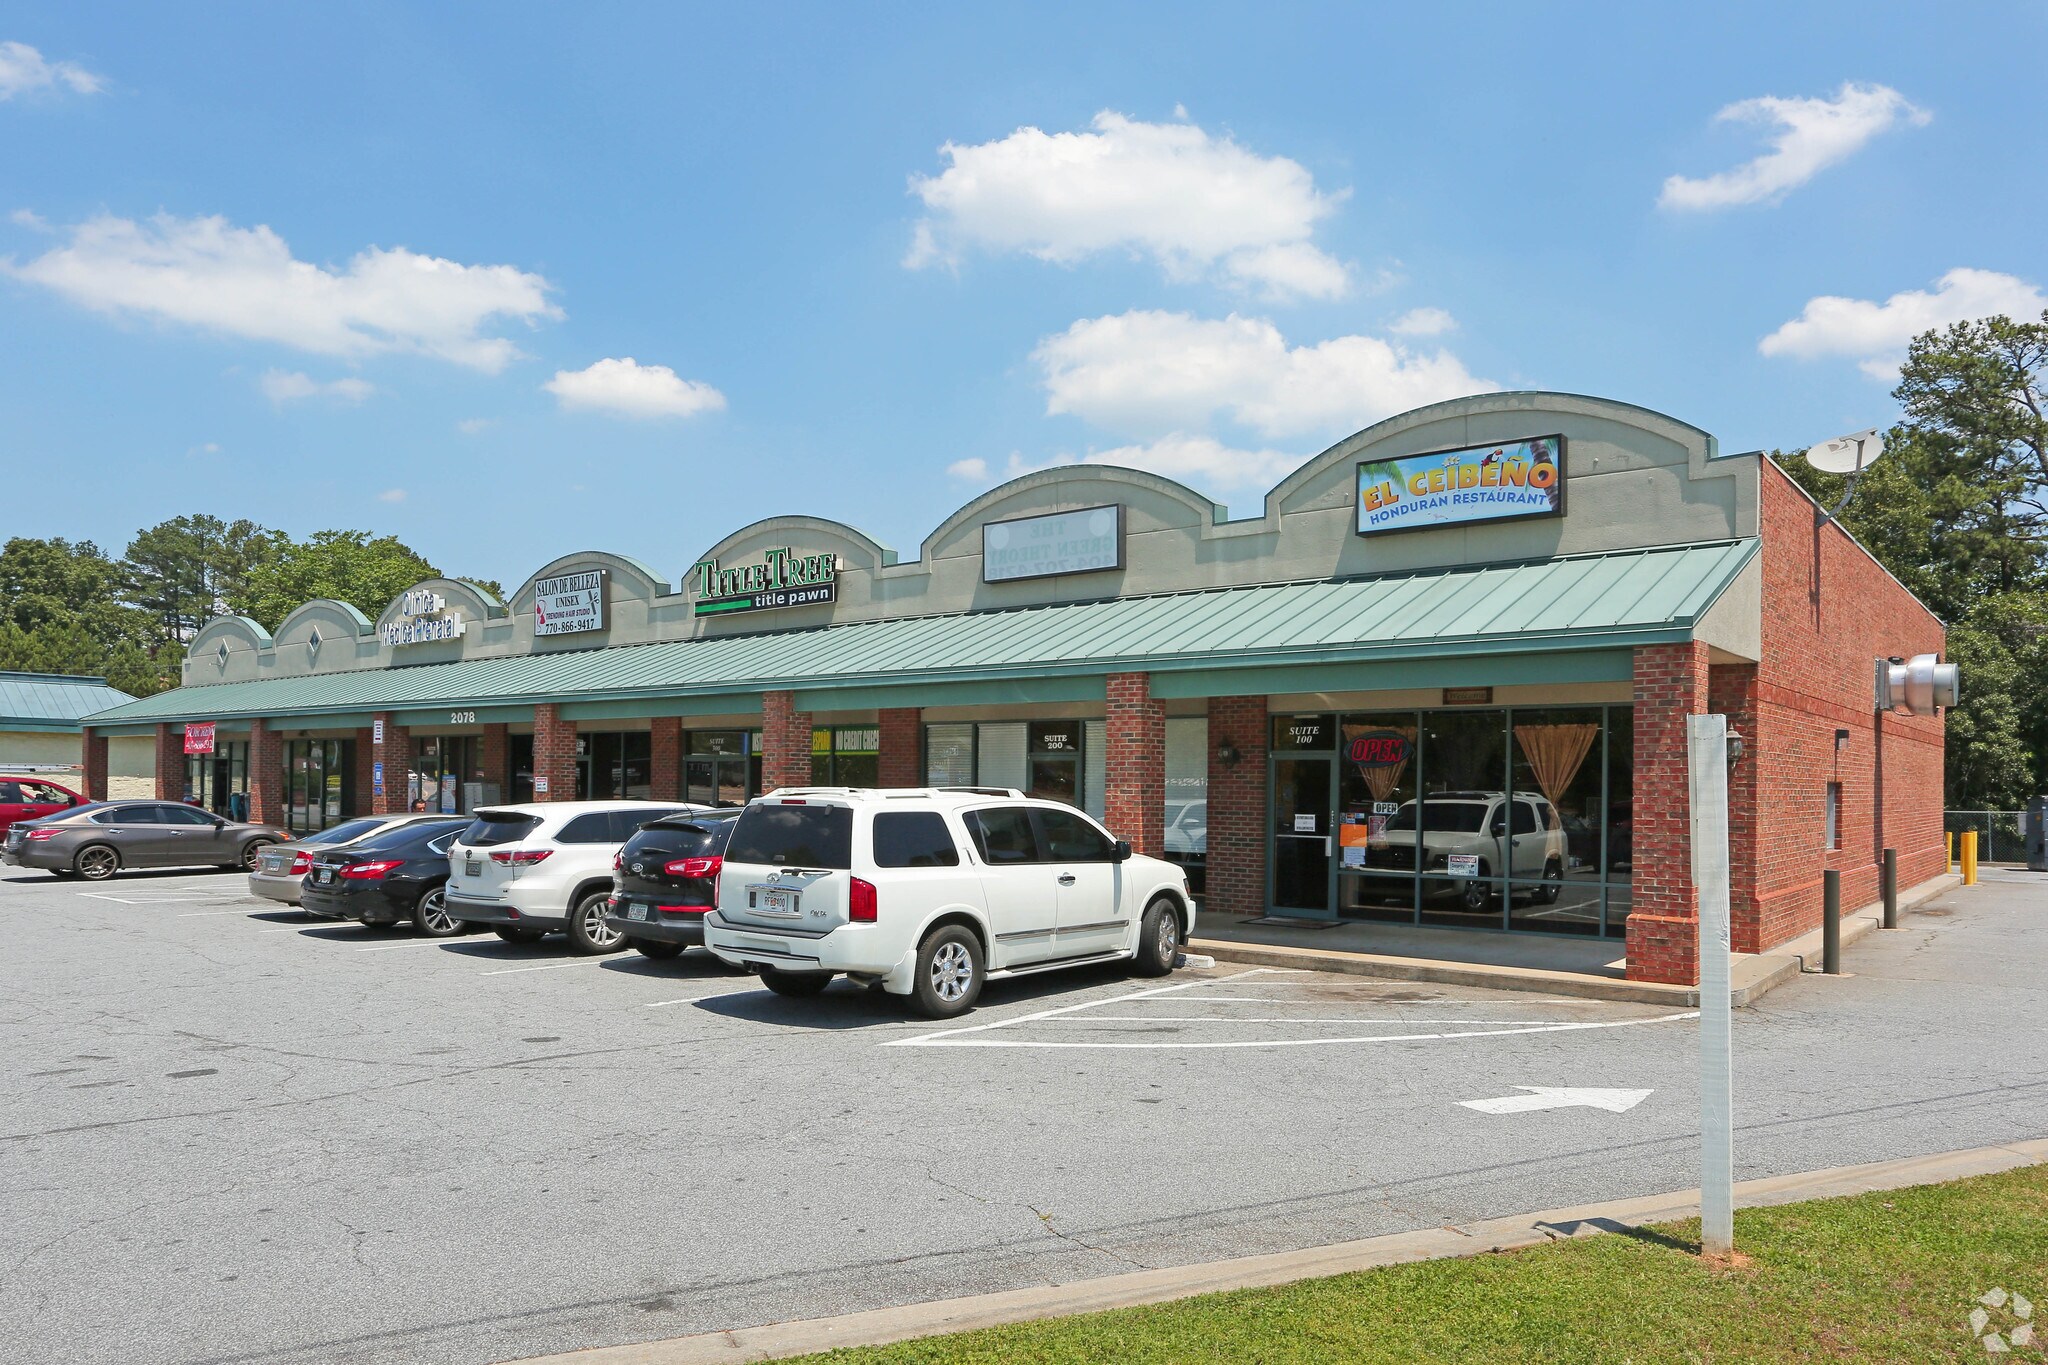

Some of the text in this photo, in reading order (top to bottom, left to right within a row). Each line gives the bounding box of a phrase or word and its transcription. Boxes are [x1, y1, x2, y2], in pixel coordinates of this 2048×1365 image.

[1362, 456, 1557, 513] EL CEIBEÑO
[1370, 491, 1547, 525] HONDURAN RESTAURANT
[537, 573, 600, 597] SALON DE BELLEZA
[555, 595, 580, 608] UNISEX
[755, 589, 829, 607] title pawn
[546, 608, 590, 620] TRENDING HAIR STUDIO
[451, 711, 475, 723] 2078
[1289, 726, 1320, 735] SUITE
[836, 731, 843, 750] NO
[844, 730, 862, 750] CREDIT
[1296, 735, 1312, 744] 100
[1351, 739, 1404, 762] OPEN
[1376, 803, 1397, 813] OPEN
